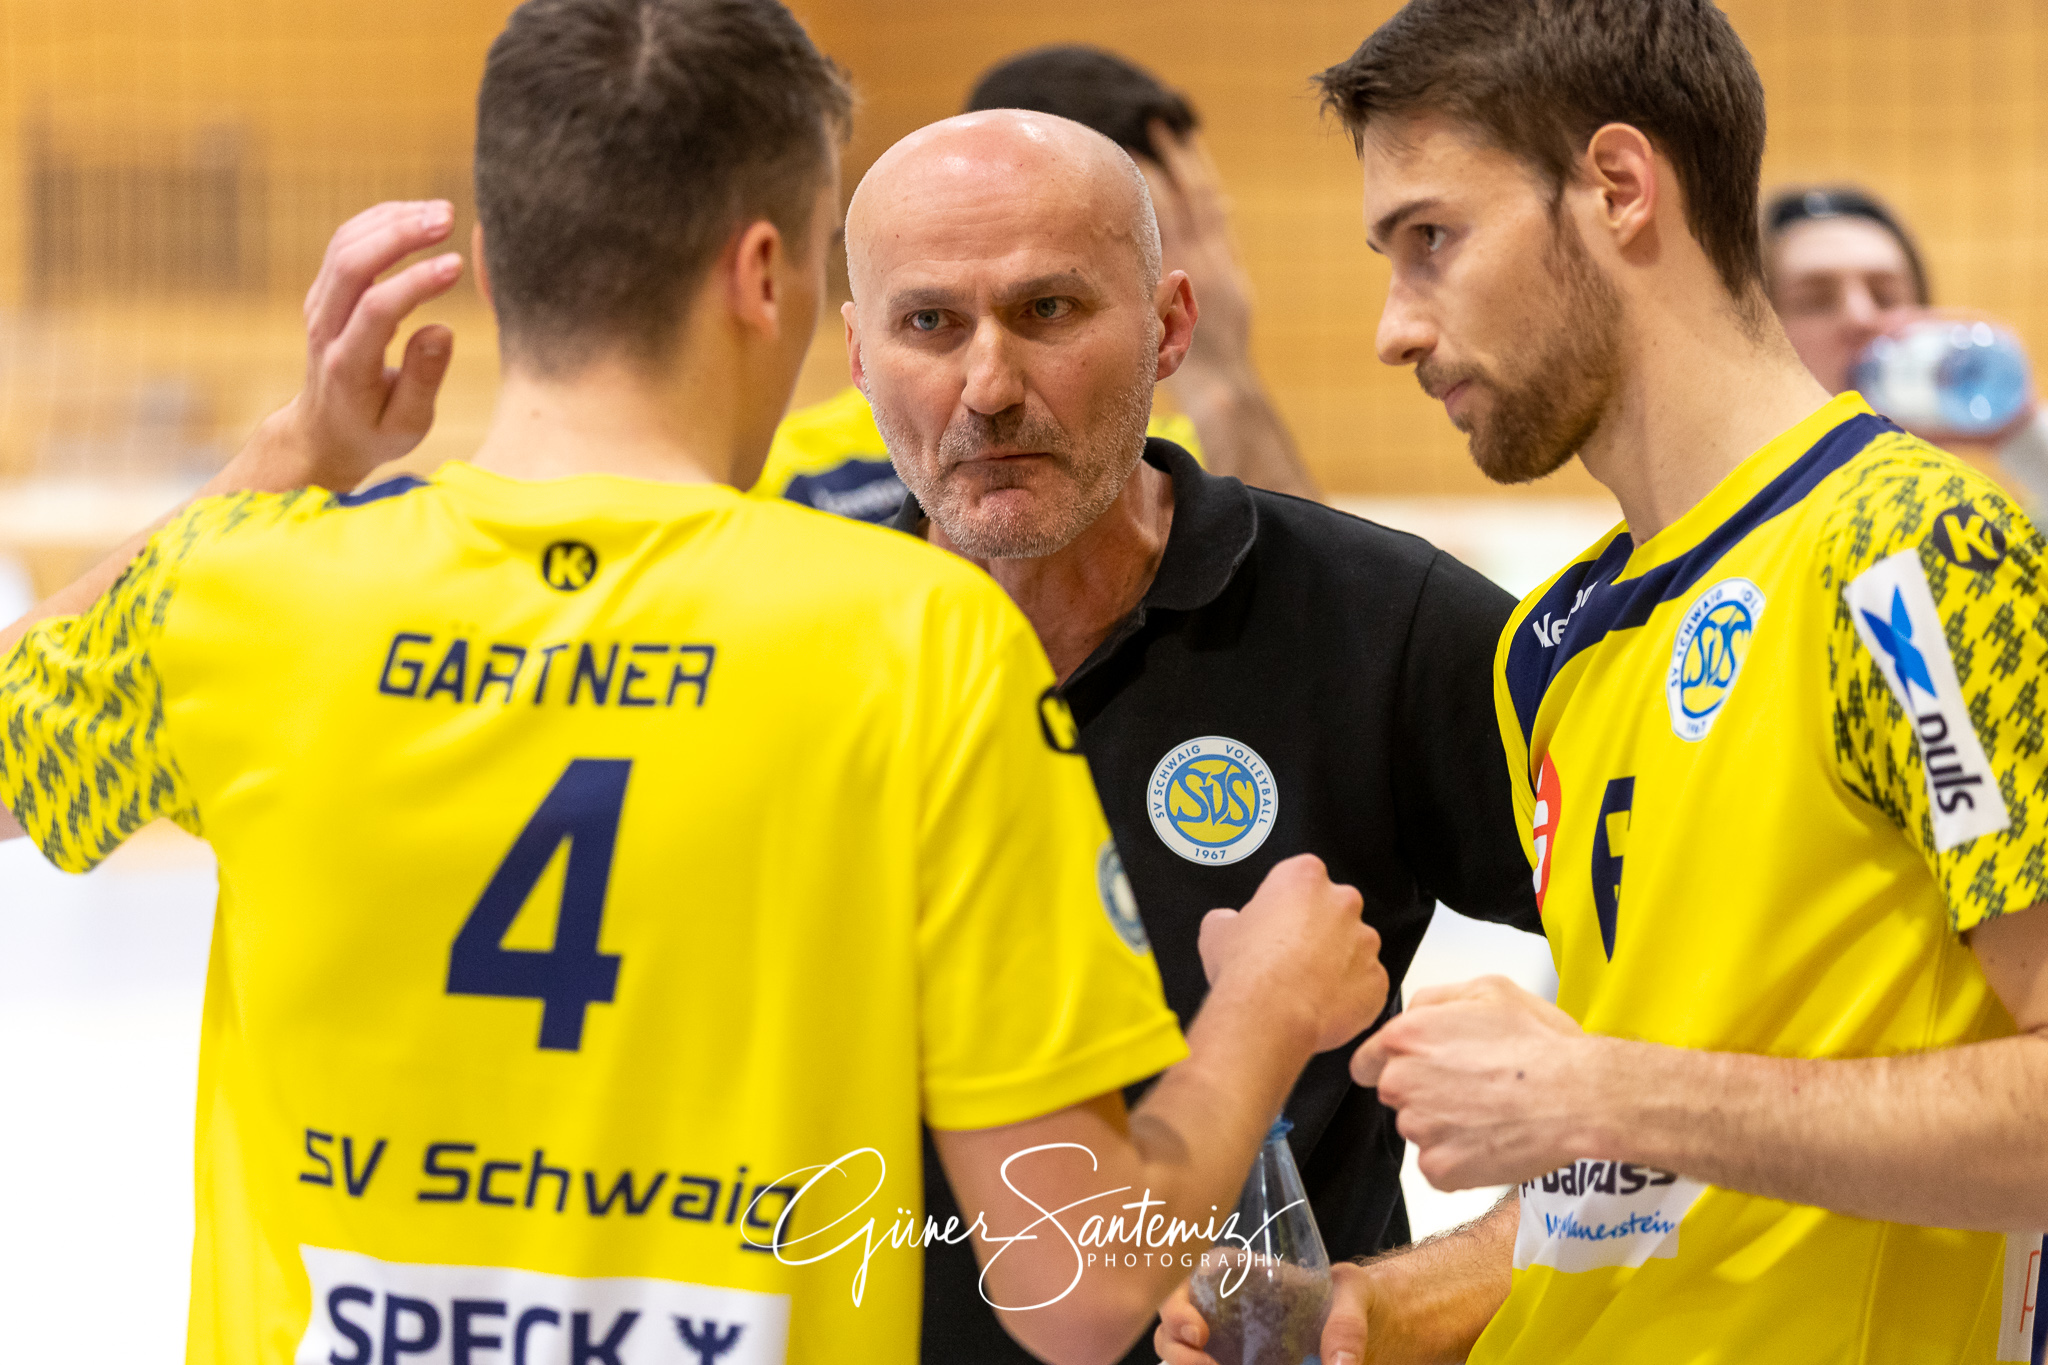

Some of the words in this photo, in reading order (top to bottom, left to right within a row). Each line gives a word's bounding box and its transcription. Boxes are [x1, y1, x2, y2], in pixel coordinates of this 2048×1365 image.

[378, 621, 716, 707] GÄRTNER
[1153, 744, 1201, 796] SCHWAIG
[1225, 744, 1272, 824] VOLLEYBALL
[1153, 802, 1165, 819] SV
[1195, 847, 1227, 860] 1967
[445, 758, 634, 1053] 4
[299, 1127, 388, 1199] SV
[416, 1148, 799, 1254] Schwaig
[327, 1284, 642, 1365] SPECK
